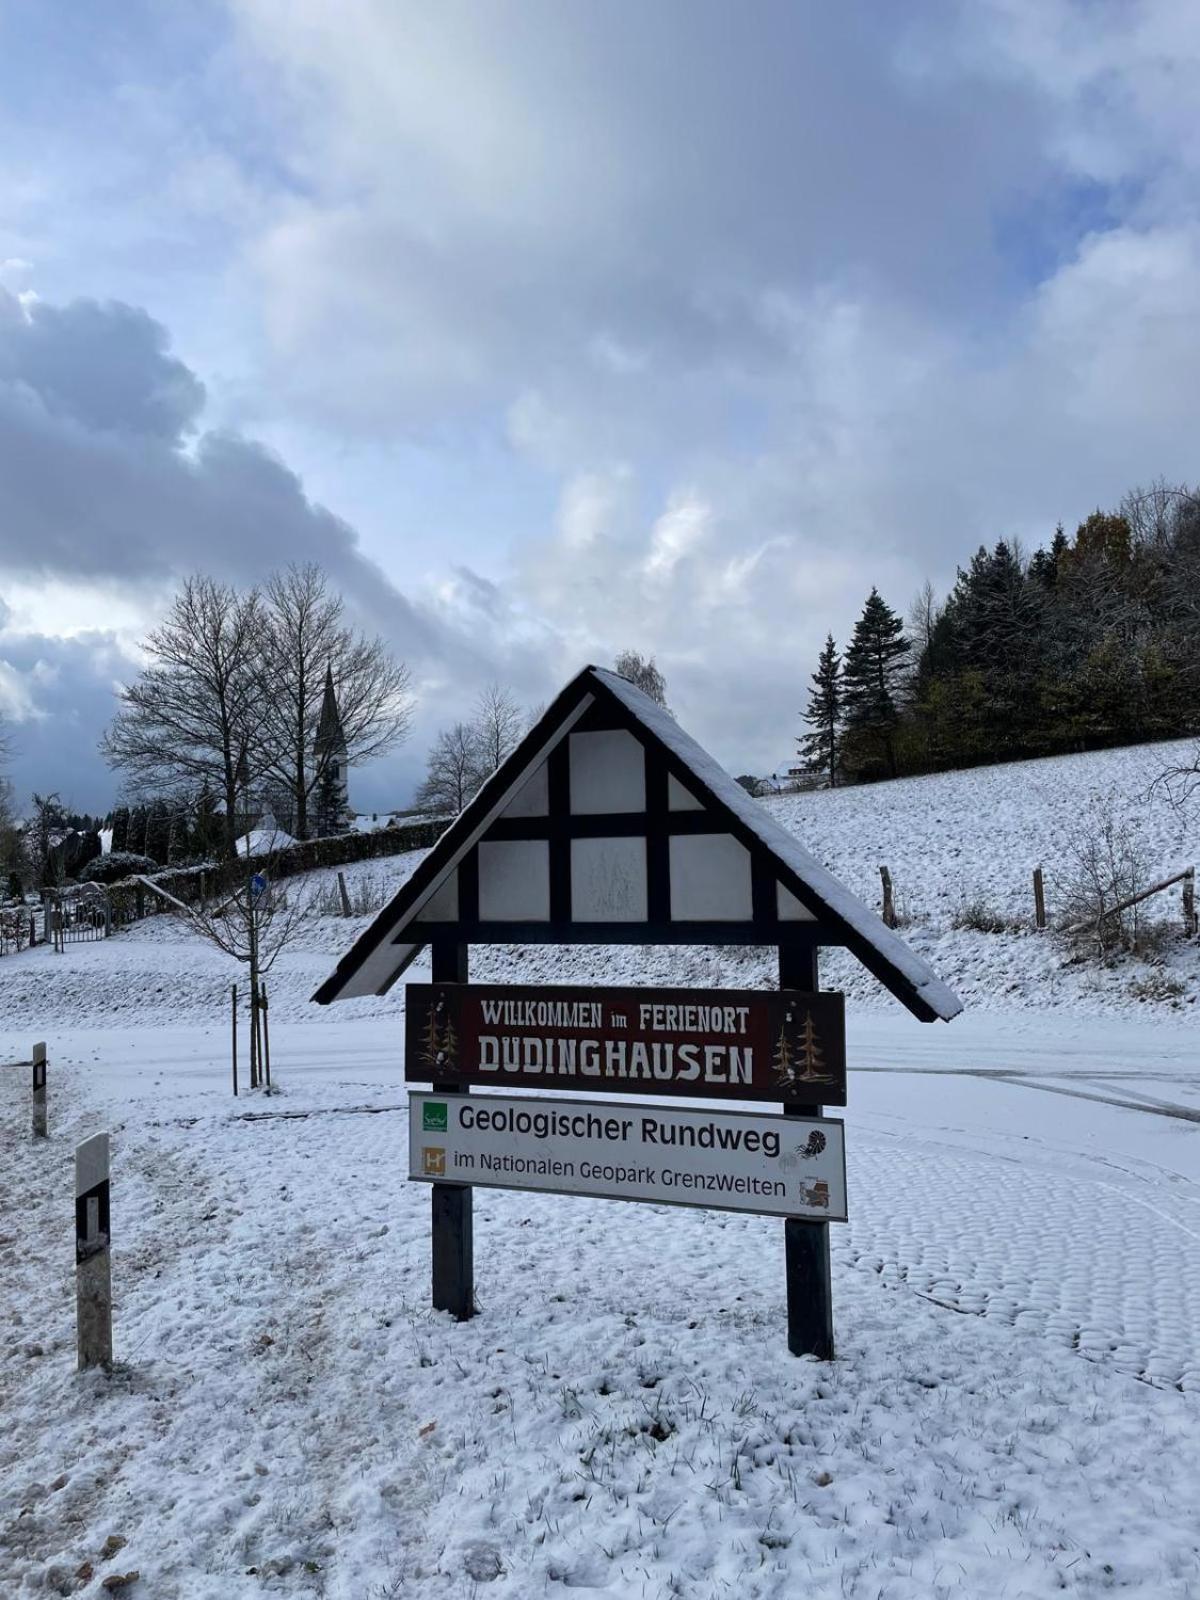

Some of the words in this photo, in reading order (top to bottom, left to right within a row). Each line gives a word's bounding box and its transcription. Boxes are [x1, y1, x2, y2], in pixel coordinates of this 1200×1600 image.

[480, 1000, 603, 1029] WILLKOMMEN
[611, 1011, 628, 1029] im
[639, 1003, 750, 1034] FERIENORT
[459, 1105, 633, 1141] Geologischer
[641, 1118, 781, 1157] Rundweg
[454, 1150, 475, 1169] im
[480, 1152, 575, 1178] Nationalen
[580, 1162, 656, 1185] Geopark
[661, 1169, 787, 1197] GrenzWelten
